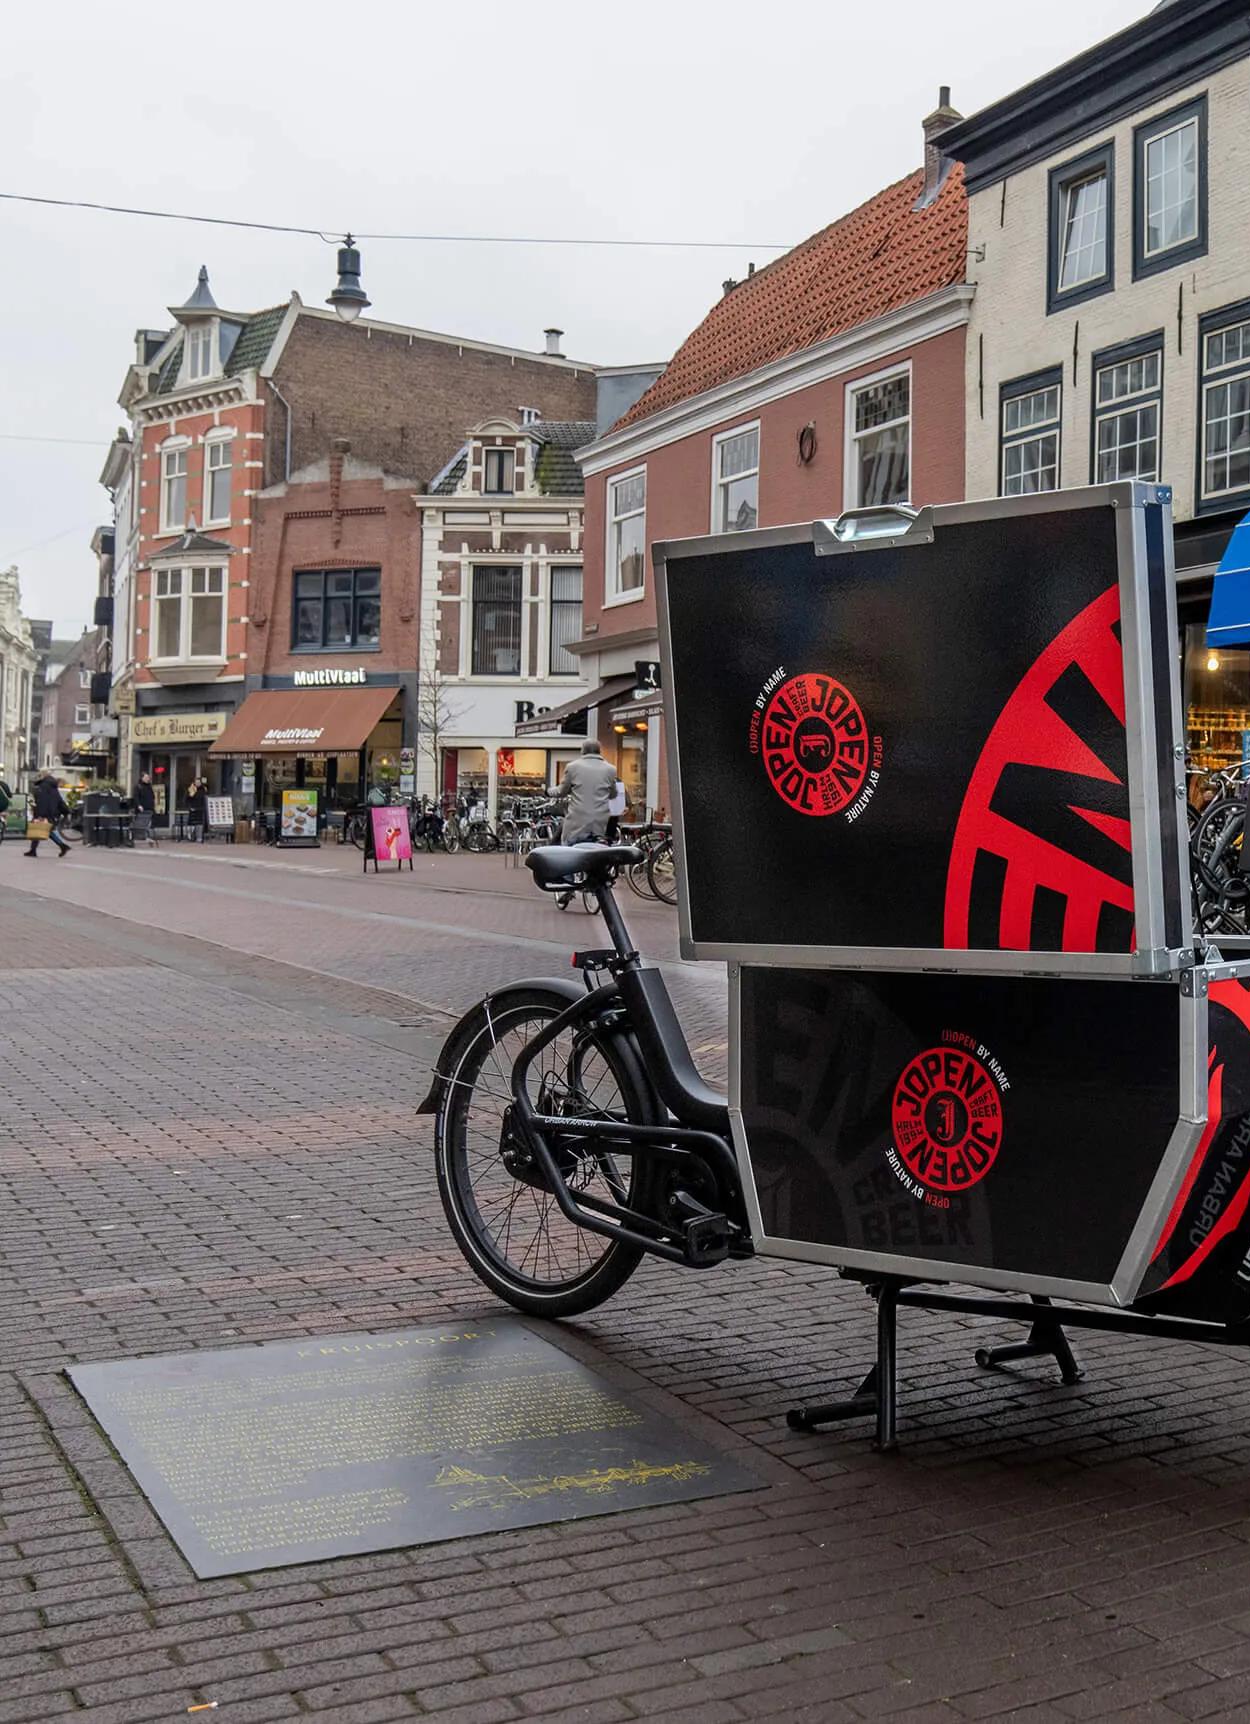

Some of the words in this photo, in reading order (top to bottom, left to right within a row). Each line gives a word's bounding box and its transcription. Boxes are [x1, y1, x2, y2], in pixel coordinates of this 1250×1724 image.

[755, 693, 768, 710] BY
[763, 666, 787, 694] NAME
[134, 718, 165, 736] Chef's
[169, 721, 205, 738] Burger
[811, 678, 866, 795] JOPEN
[766, 695, 818, 810] JOPEN
[873, 735, 883, 768] OPEN
[868, 770, 880, 788] BY
[845, 786, 874, 824] NATURE
[896, 1053, 986, 1117] JOPEN
[977, 1044, 990, 1060] BY
[988, 1057, 1011, 1092] NAME
[971, 1103, 998, 1119] BEER
[885, 1147, 913, 1191] NATURE
[907, 1121, 998, 1186] JOPEN
[911, 1182, 924, 1199] BY
[925, 1191, 950, 1209] OPEN
[297, 1327, 497, 1359] KRUISPOORT
